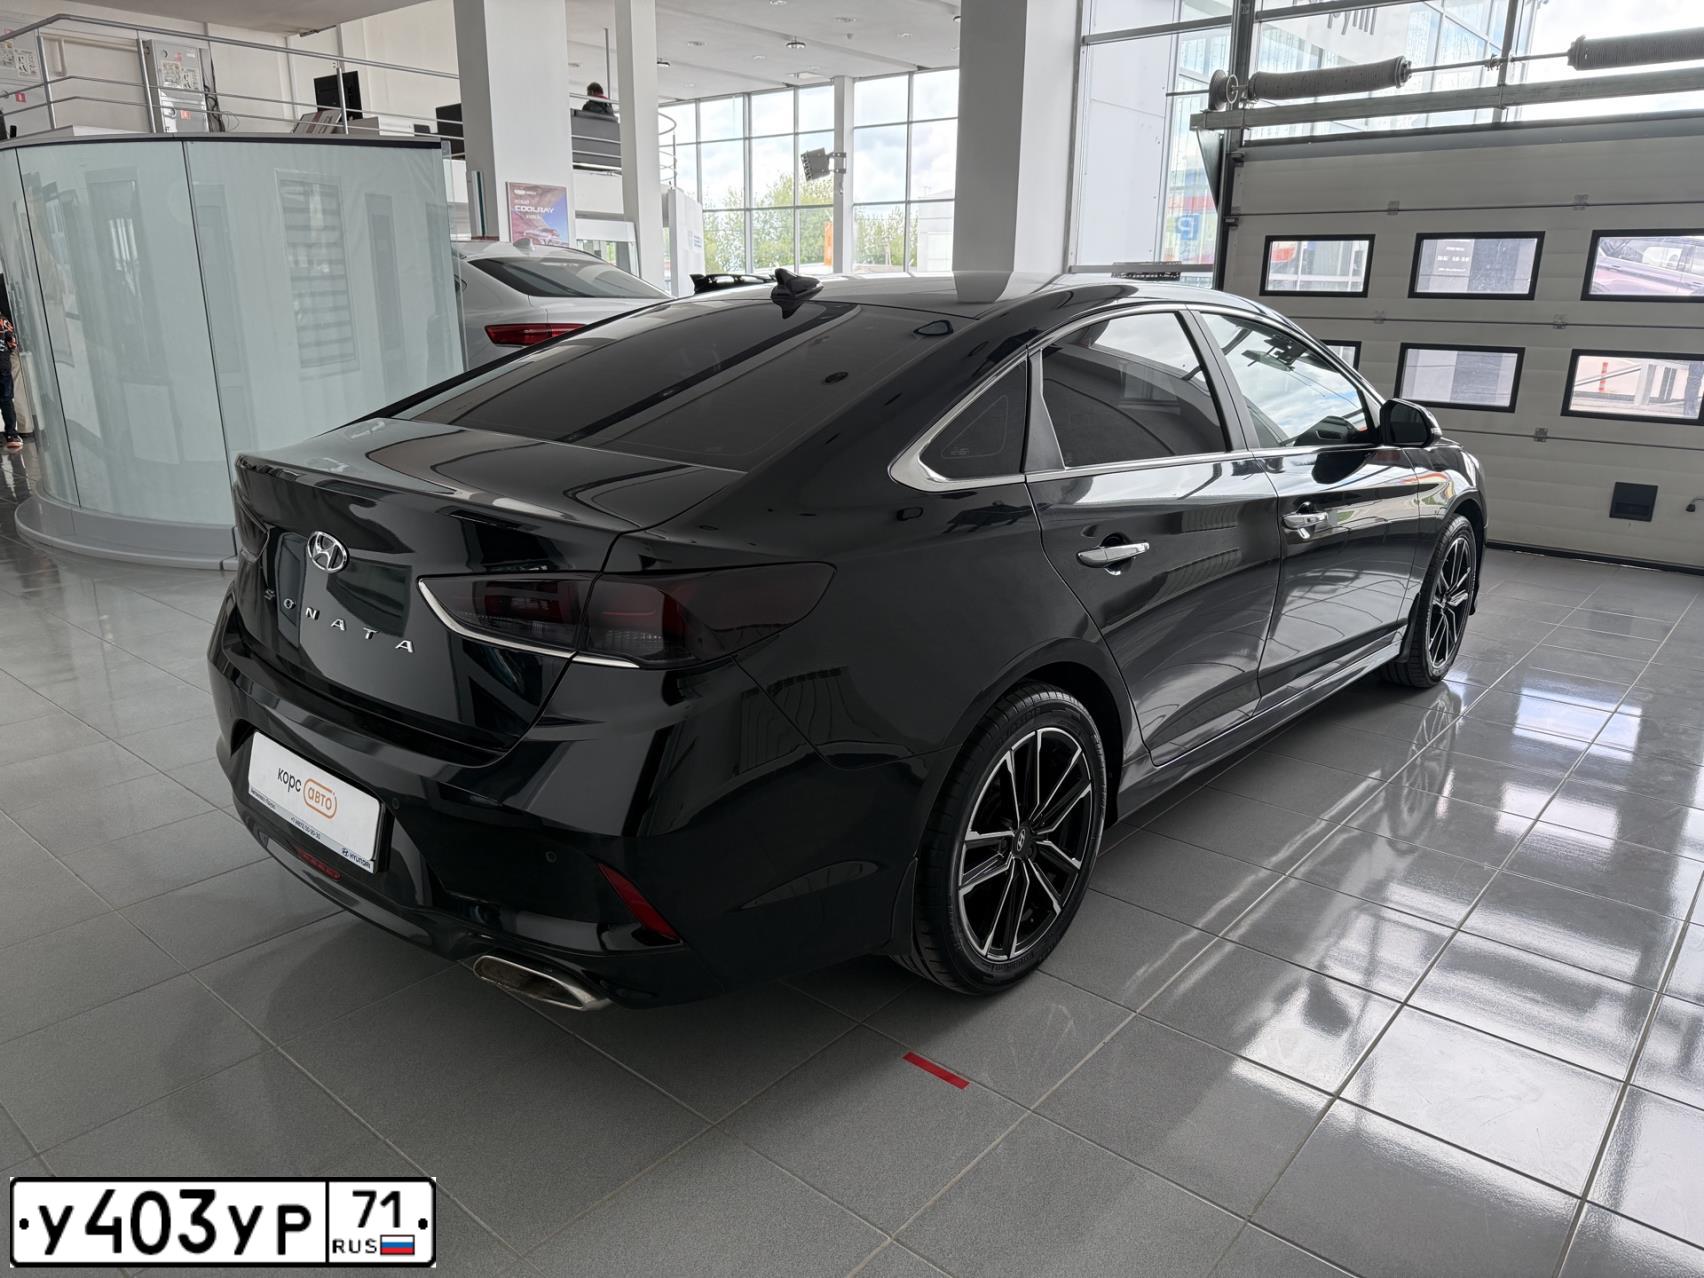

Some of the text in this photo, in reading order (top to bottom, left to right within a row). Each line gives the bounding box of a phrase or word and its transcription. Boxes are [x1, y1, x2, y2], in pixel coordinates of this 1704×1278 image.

[514, 205, 554, 214] COOLRAY
[264, 588, 415, 654] SONATA
[277, 767, 333, 811] корс авто
